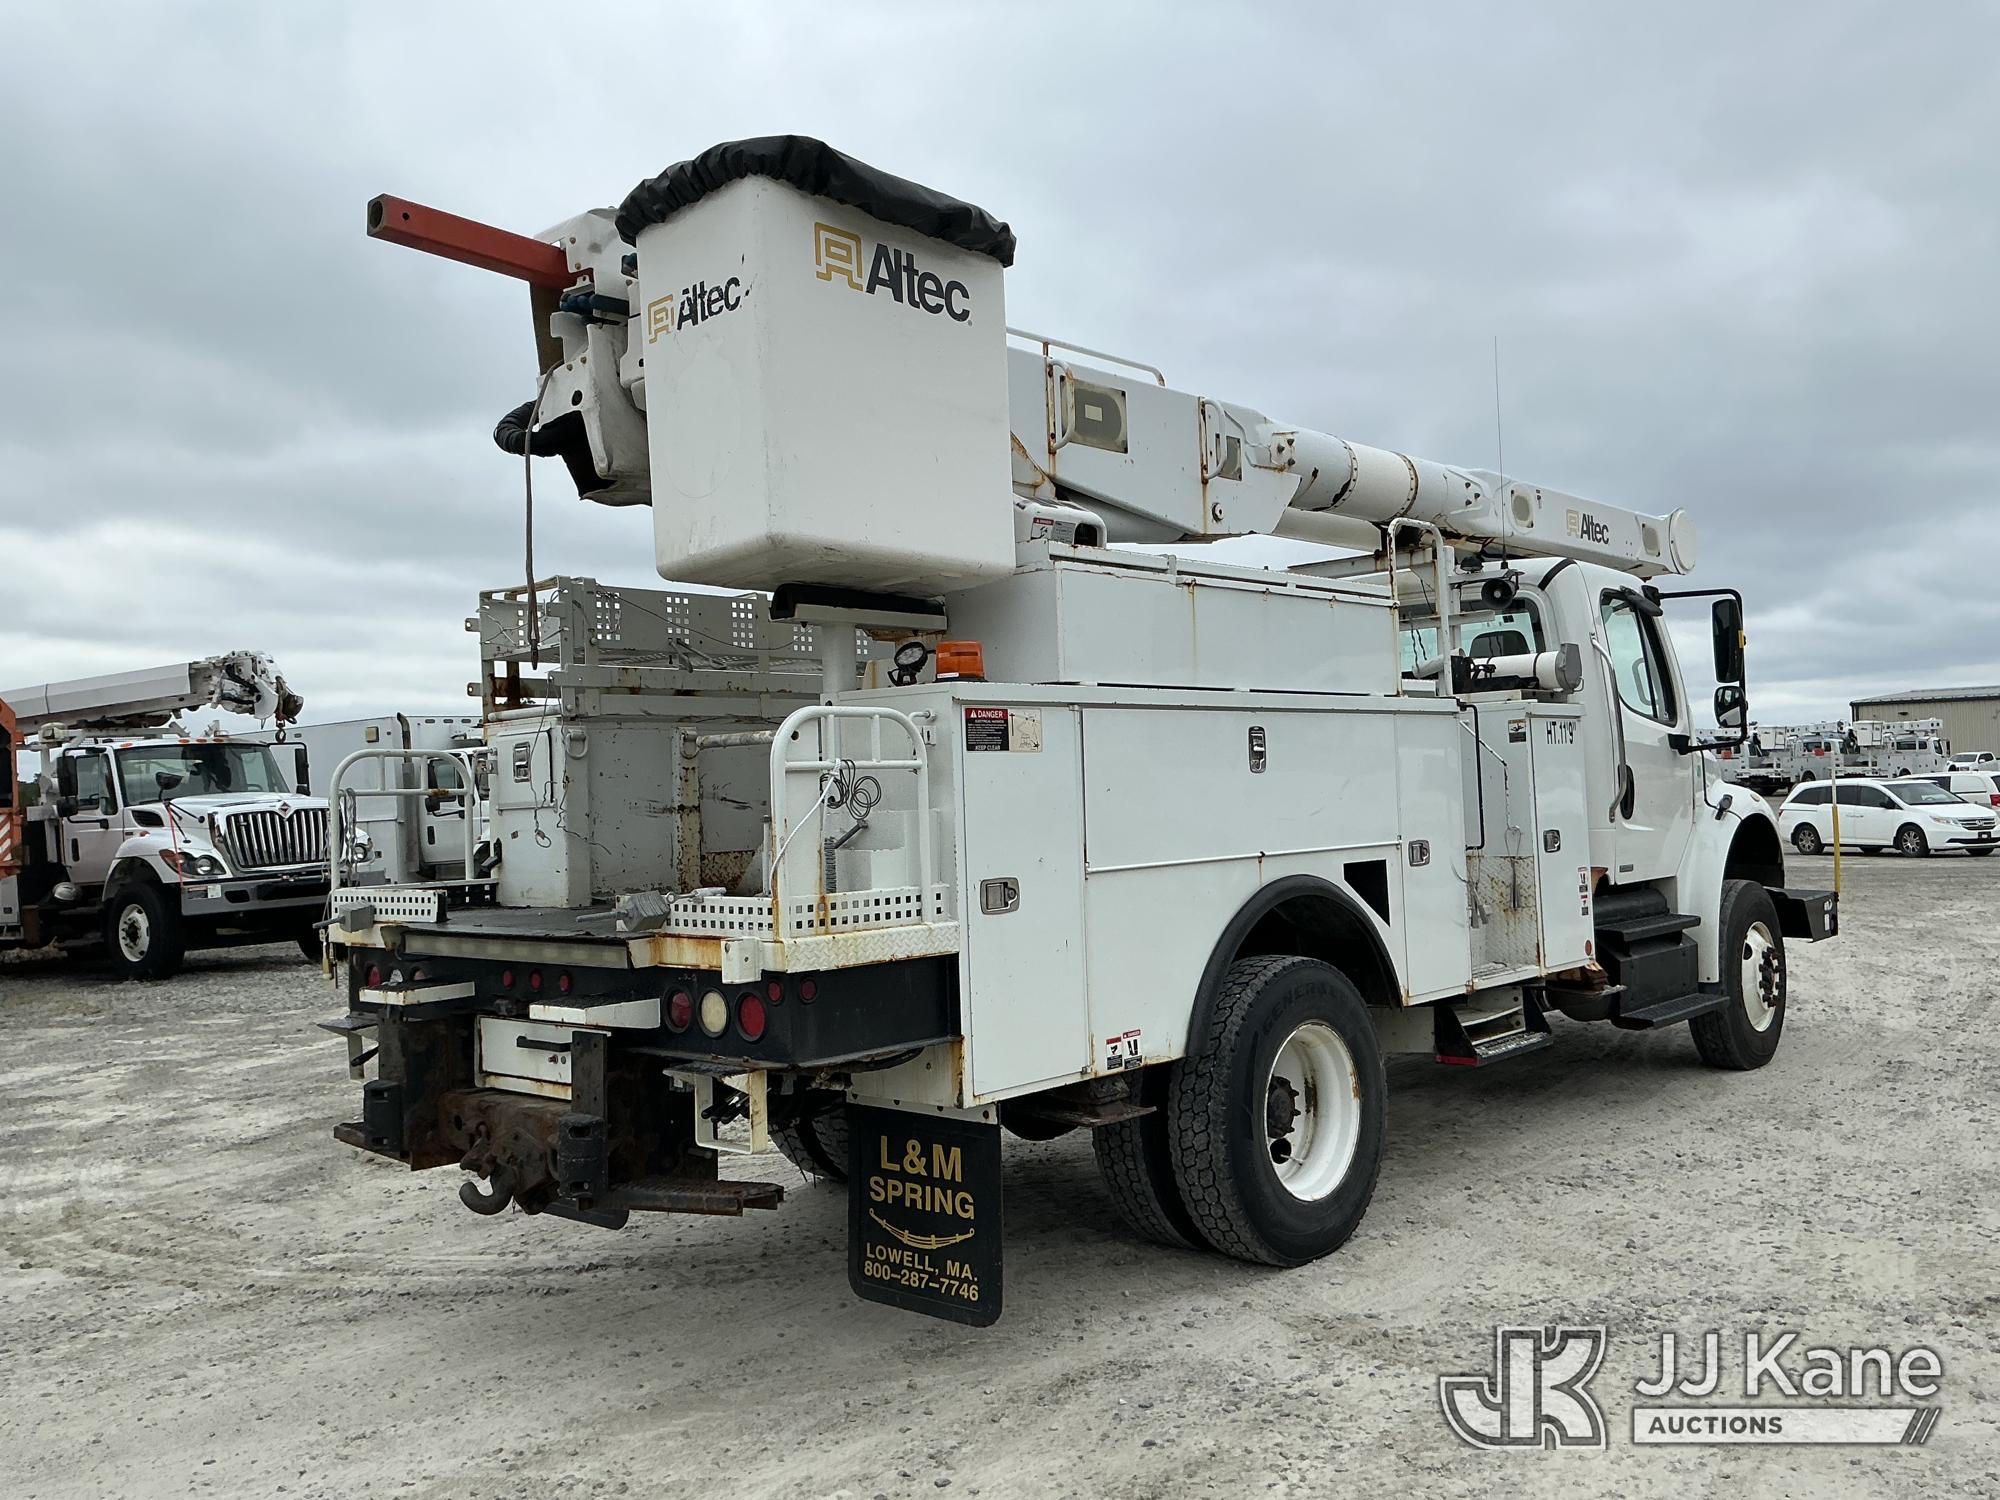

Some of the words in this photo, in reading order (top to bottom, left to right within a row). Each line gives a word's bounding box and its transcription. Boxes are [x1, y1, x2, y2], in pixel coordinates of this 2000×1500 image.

[676, 276, 742, 331] Altec
[865, 243, 970, 322] Altec
[1580, 513, 1609, 545] Altec
[977, 710, 1003, 718] DANGER
[880, 1135, 962, 1183] L&M
[869, 1176, 975, 1220] SPRING
[864, 1260, 980, 1302] 800-287-7746
[866, 1242, 939, 1276] LOWELL,
[946, 1259, 979, 1282] MA.
